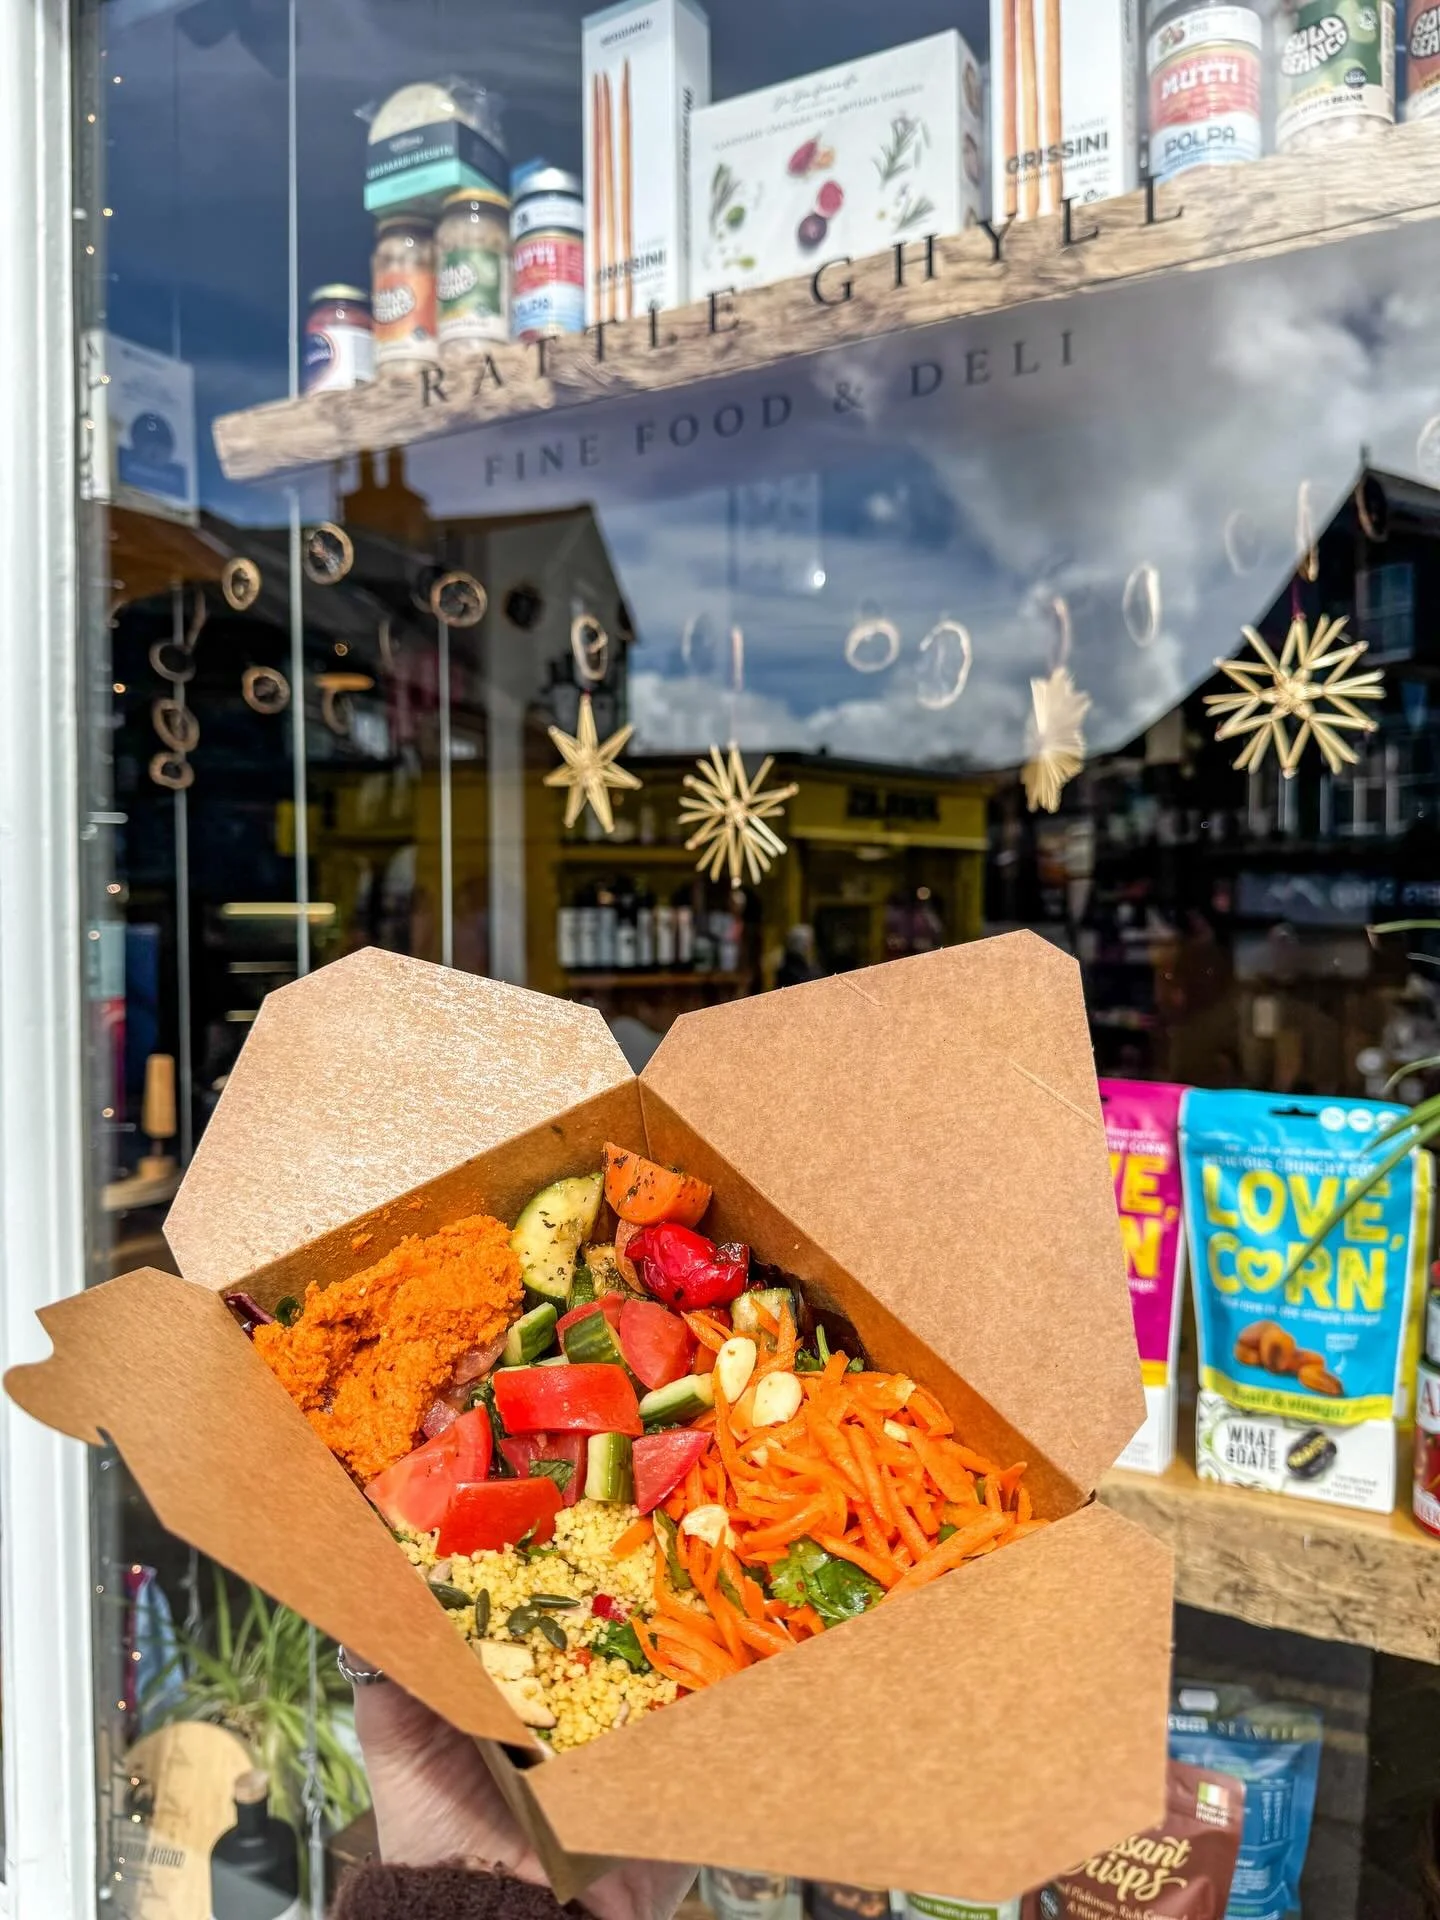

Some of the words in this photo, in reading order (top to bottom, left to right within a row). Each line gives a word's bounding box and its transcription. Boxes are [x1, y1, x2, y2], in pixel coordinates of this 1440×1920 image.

[1160, 61, 1240, 100] MUTTI
[1164, 125, 1236, 157] POLPA
[419, 286, 742, 408] RATTLE
[811, 173, 1184, 306] GHYLL
[484, 432, 600, 487] FINE
[634, 393, 792, 456] FOOD
[832, 380, 864, 414] &
[909, 327, 1074, 397] DELI
[1208, 1231, 1387, 1312] CORN
[1227, 1423, 1277, 1448] WHAT
